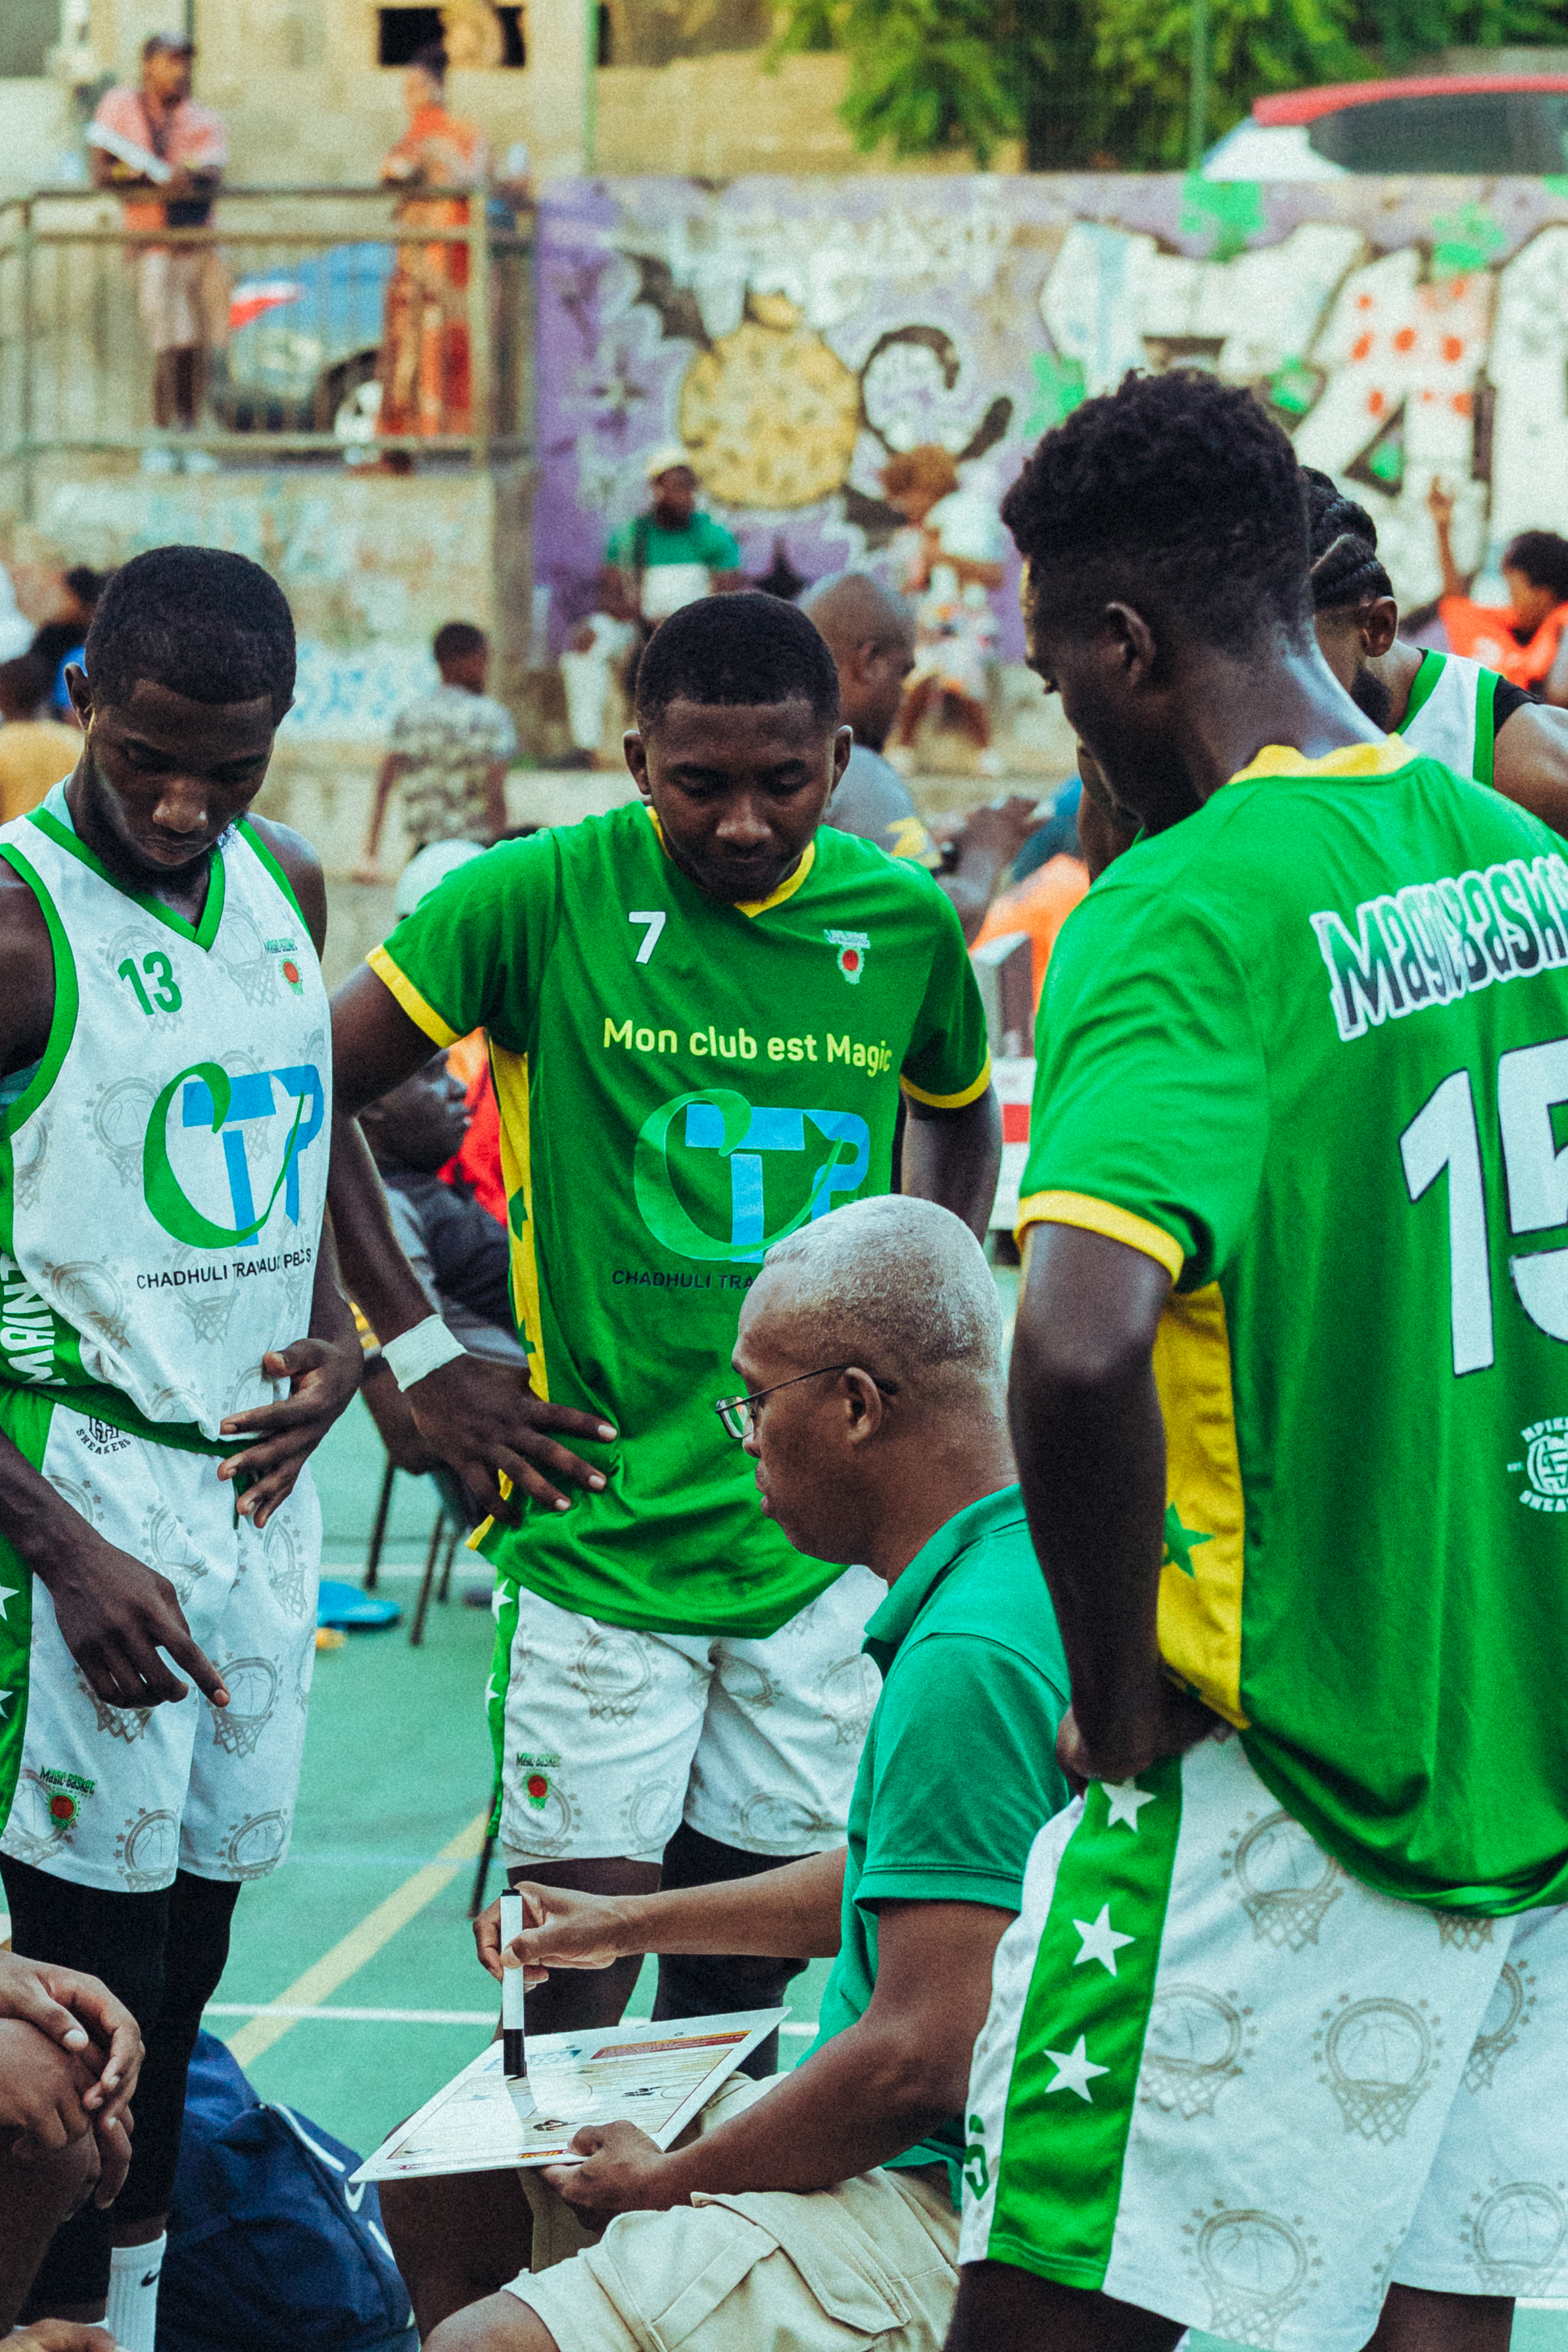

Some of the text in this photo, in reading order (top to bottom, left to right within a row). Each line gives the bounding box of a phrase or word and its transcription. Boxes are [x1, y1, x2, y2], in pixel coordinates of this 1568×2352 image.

[629, 911, 666, 965] 7
[118, 951, 182, 1015] 13
[604, 1018, 892, 1077] Mon club est Magic
[143, 1062, 324, 1249] CTP
[1399, 1036, 1568, 1378] 15
[137, 1265, 227, 1289] CHADHULI
[611, 1270, 757, 1289] CHADHULI TRA
[76, 1428, 131, 1454] SNEAKERS
